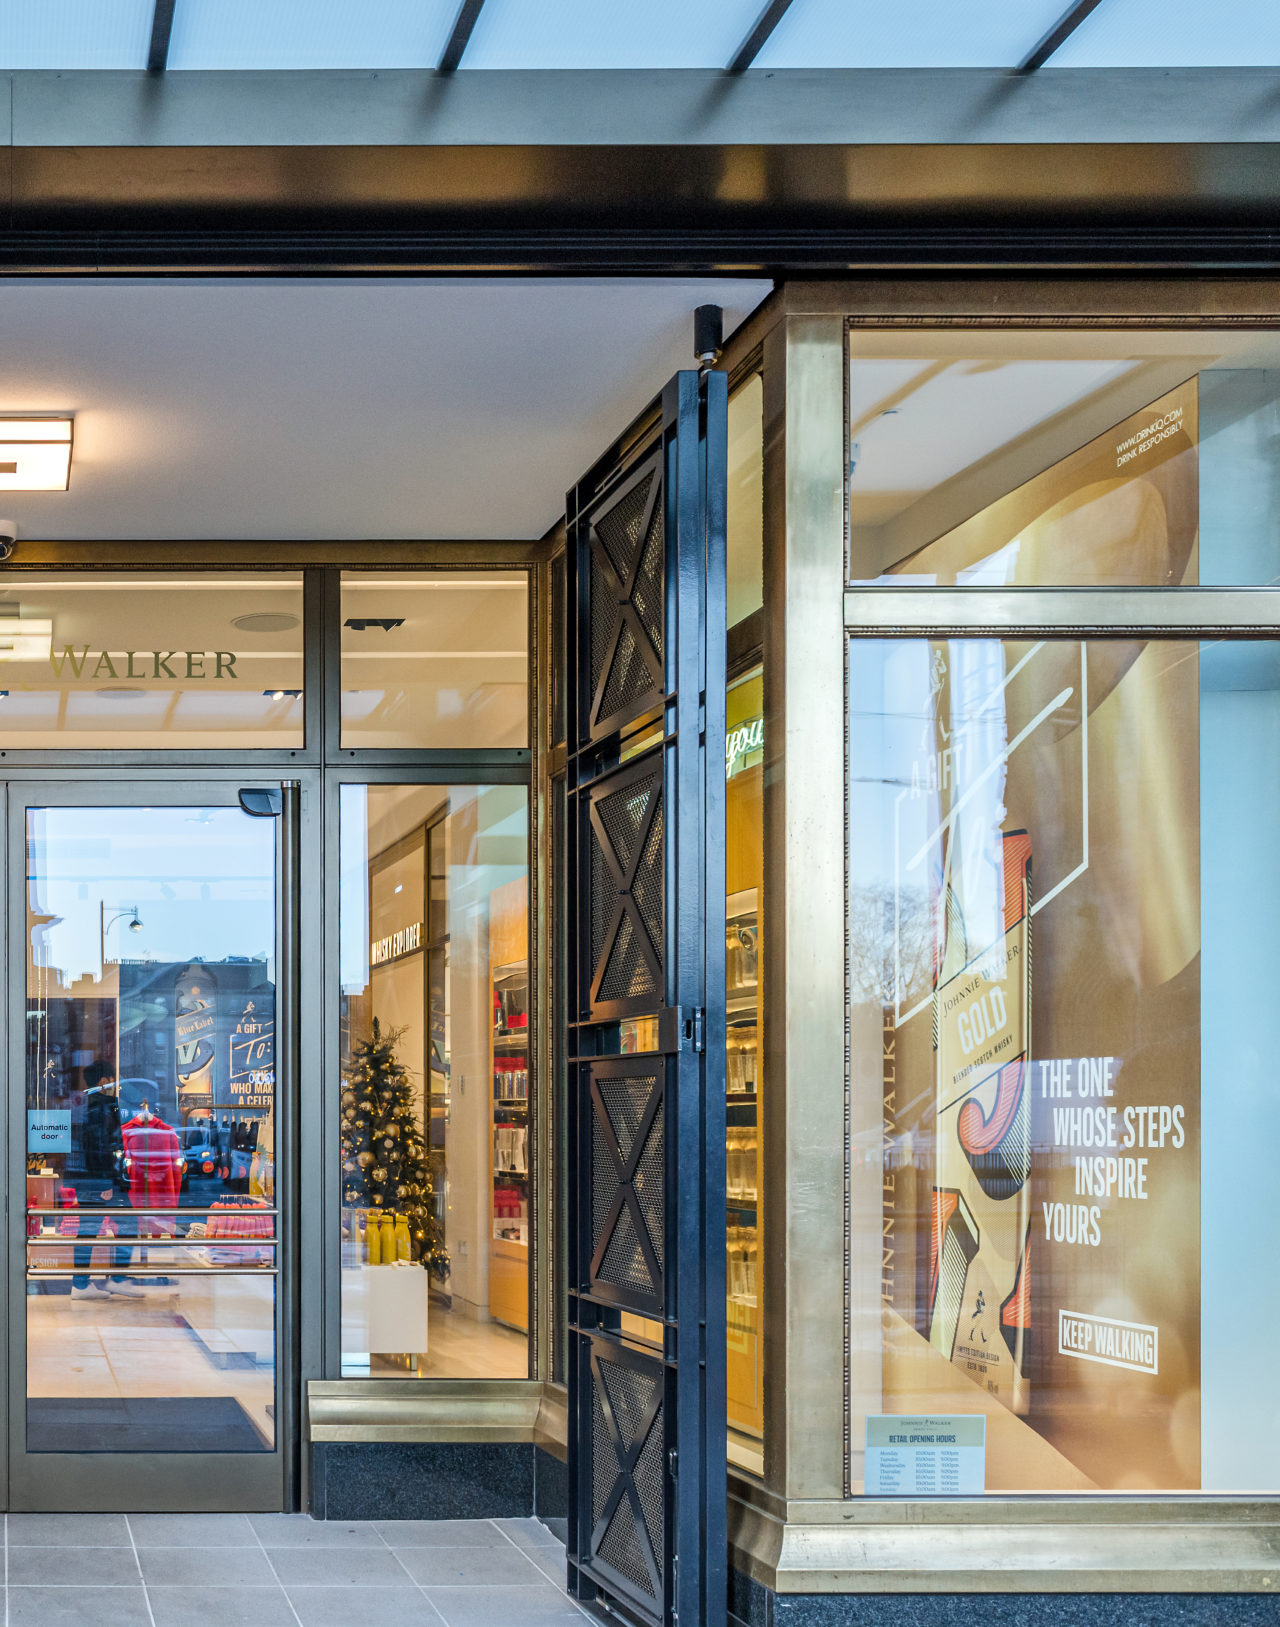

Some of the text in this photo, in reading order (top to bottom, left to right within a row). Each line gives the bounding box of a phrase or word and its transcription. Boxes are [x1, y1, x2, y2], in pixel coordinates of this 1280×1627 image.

[1116, 419, 1183, 468] DRINK RESPONSIBLY
[50, 644, 239, 679] WALKER
[943, 977, 981, 1018] JOHNNIE
[236, 1023, 262, 1033] A GIFT
[957, 985, 1007, 1055] GOLD
[230, 1083, 251, 1094] WHO
[1039, 1056, 1114, 1098] THE ONE
[238, 1096, 244, 1105] A
[1053, 1104, 1185, 1149] WHOSE STEPS
[1075, 1156, 1149, 1200] INSPIRE
[1042, 1202, 1101, 1247] YOURS
[1063, 1318, 1153, 1365] KEEP WALKING
[889, 1435, 956, 1443] RETAIL OPENING HOURS
